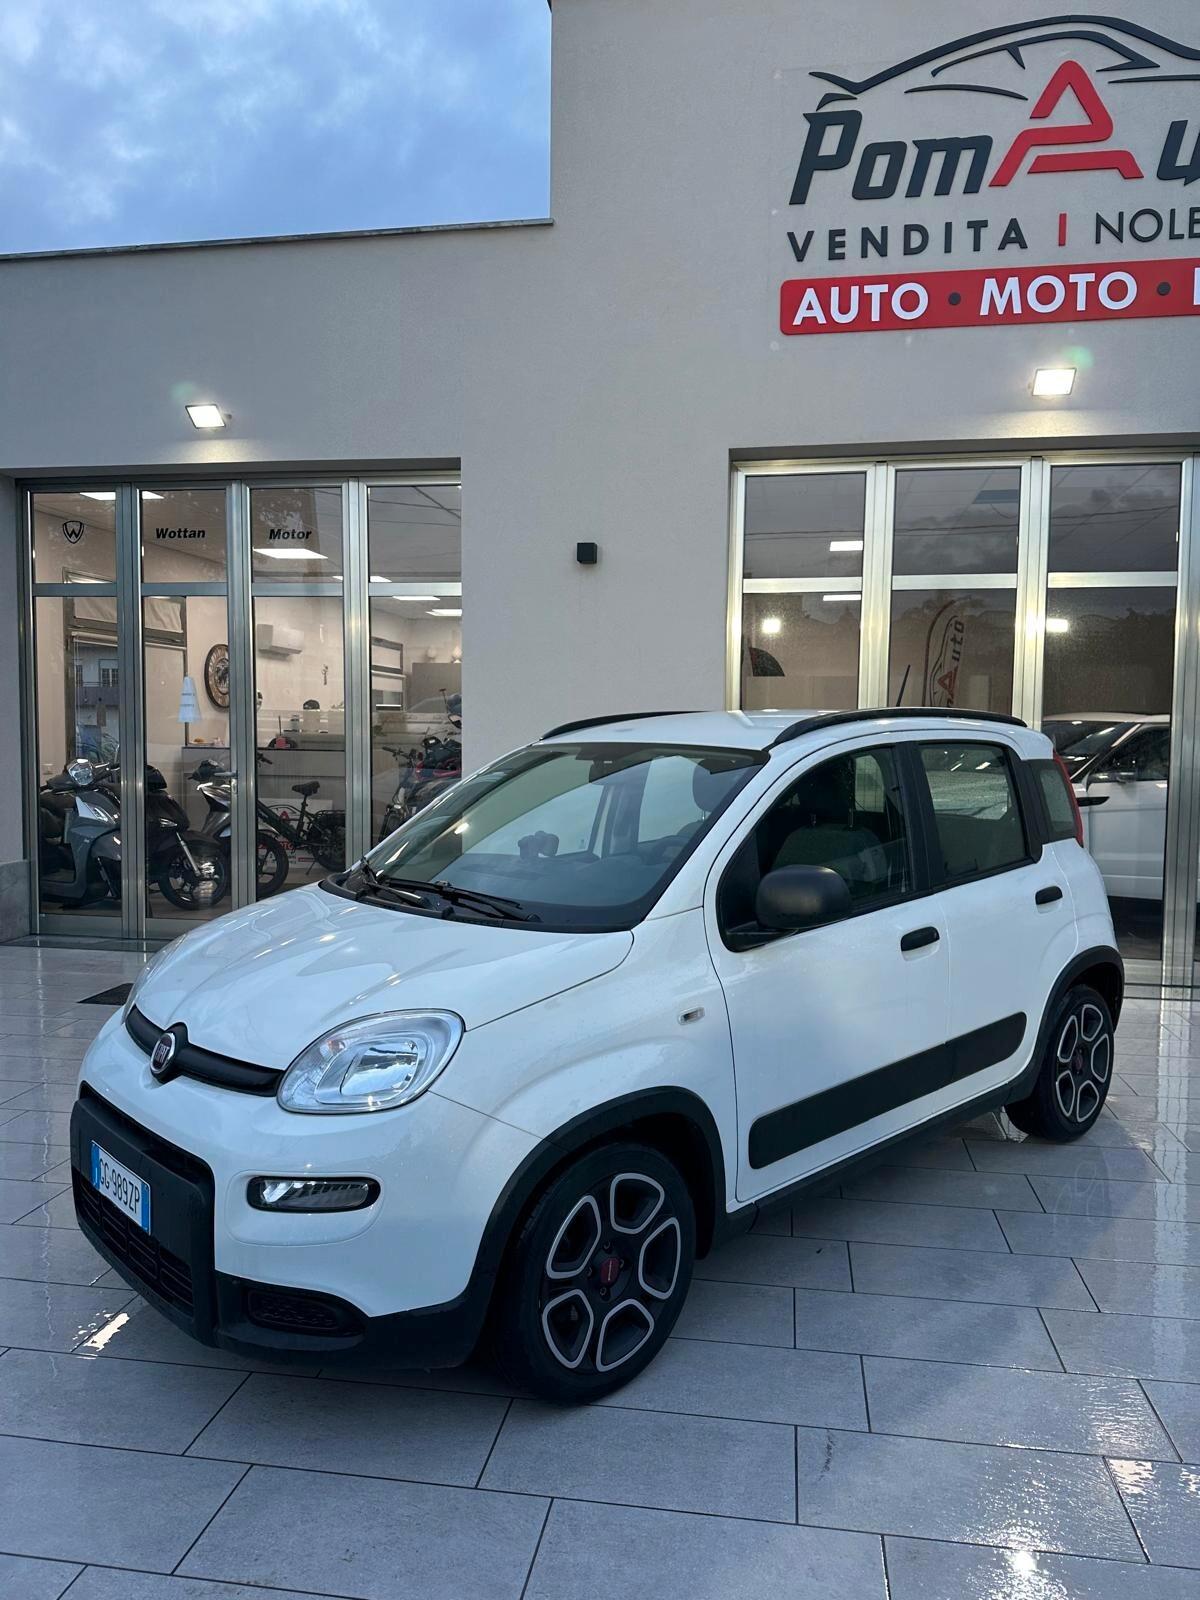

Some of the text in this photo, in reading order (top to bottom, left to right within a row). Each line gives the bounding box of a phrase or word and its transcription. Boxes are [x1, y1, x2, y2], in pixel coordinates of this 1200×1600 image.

[787, 217, 1028, 262] VENDITA
[792, 271, 1138, 326] AUTO MOTO
[155, 527, 312, 541] Wottan Motor
